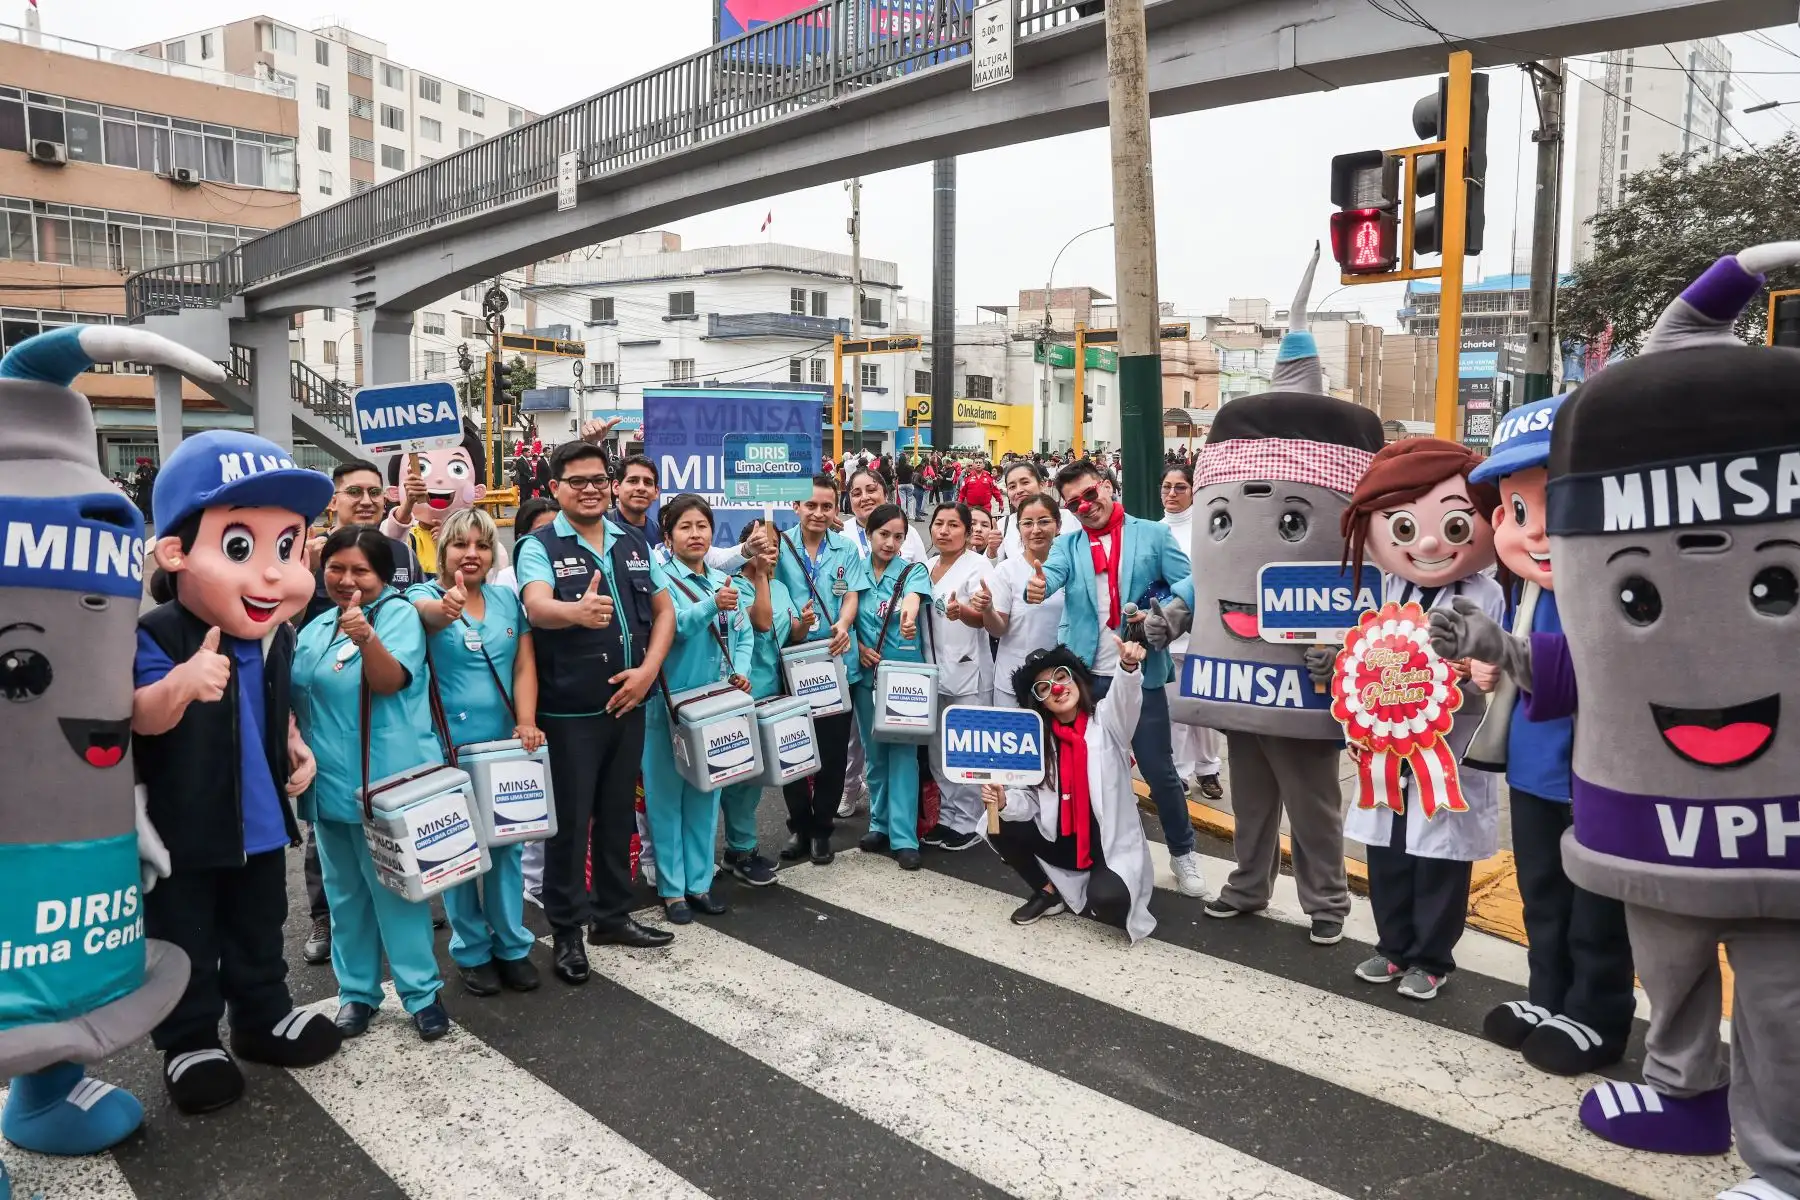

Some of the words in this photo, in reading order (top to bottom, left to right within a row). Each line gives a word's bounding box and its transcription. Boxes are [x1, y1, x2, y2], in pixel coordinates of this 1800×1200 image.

[977, 52, 1008, 68] ALTURA
[975, 65, 1010, 84] MAXIMA
[1463, 340, 1495, 348] charbel
[359, 401, 456, 430] MINSA
[748, 446, 786, 460] DIRIS
[736, 460, 761, 472] Lima
[764, 460, 801, 472] Centro
[626, 559, 649, 567] MINSA
[1264, 587, 1379, 612] MINSA
[1365, 648, 1409, 671] Felices
[799, 674, 831, 688] MINSA
[1192, 658, 1304, 708] MINSA
[1381, 666, 1430, 688] Fiestas
[892, 685, 924, 695] MINSA
[1362, 682, 1425, 710] Patrias
[710, 730, 744, 748] MINSA
[780, 729, 806, 744] MINSA
[947, 729, 1038, 755] MINSA
[499, 779, 538, 792] MINSA
[417, 811, 461, 838] MINSA
[416, 838, 433, 850] DIRIS
[432, 832, 447, 844] LIMA
[446, 821, 469, 836] CENTRO
[36, 885, 138, 935] DIRIS
